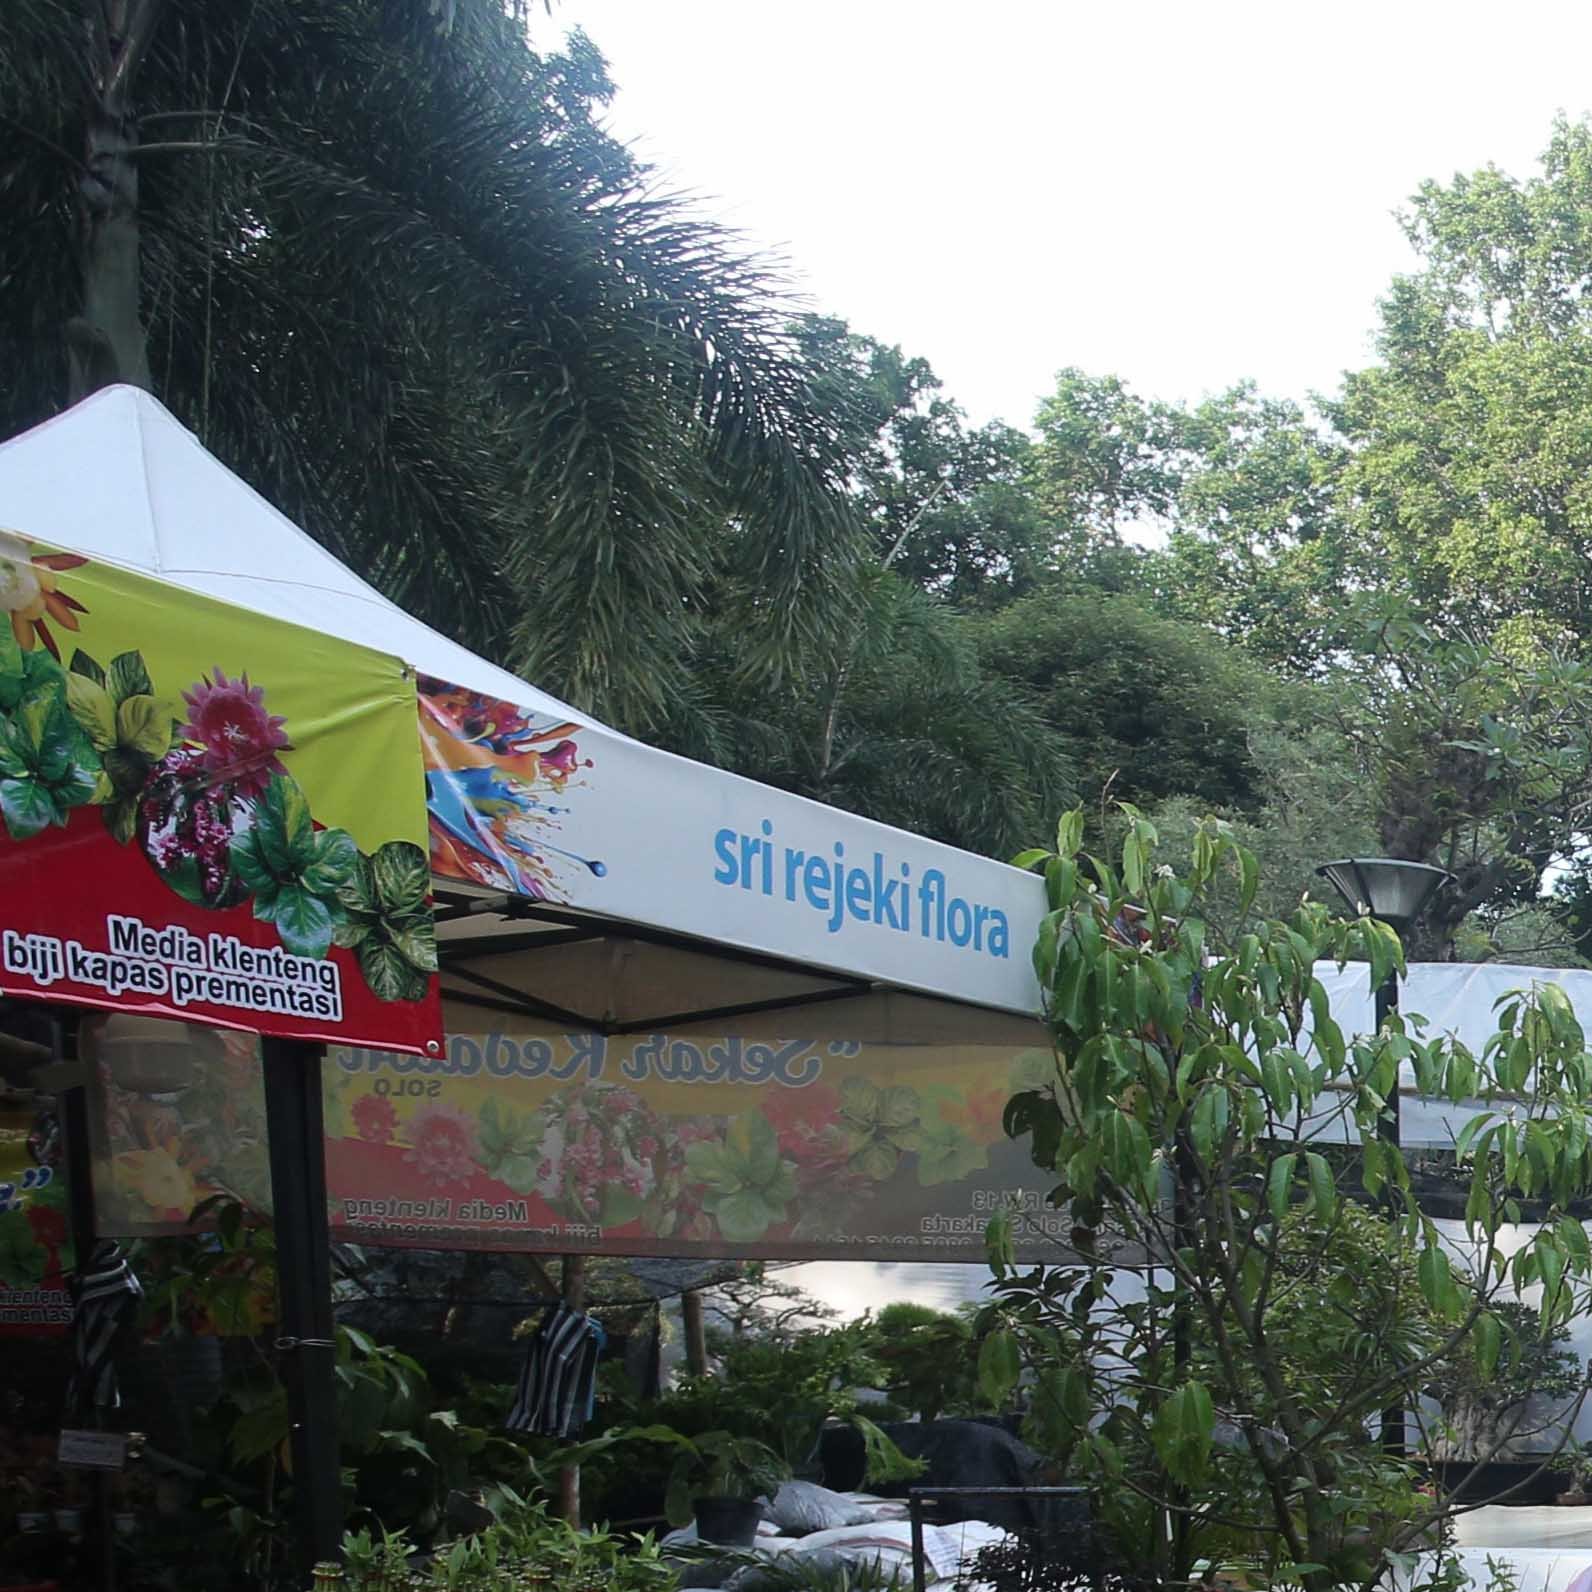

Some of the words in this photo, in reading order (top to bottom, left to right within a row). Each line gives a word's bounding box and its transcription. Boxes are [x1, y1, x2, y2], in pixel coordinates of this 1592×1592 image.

[714, 819, 773, 895] sri
[785, 841, 910, 933] rejeki
[918, 869, 1008, 958] flora
[8, 935, 62, 981] biji
[73, 950, 164, 992] kapas
[176, 973, 340, 1017] prementasi
[113, 916, 202, 963] Media
[213, 934, 337, 991] klenteng
